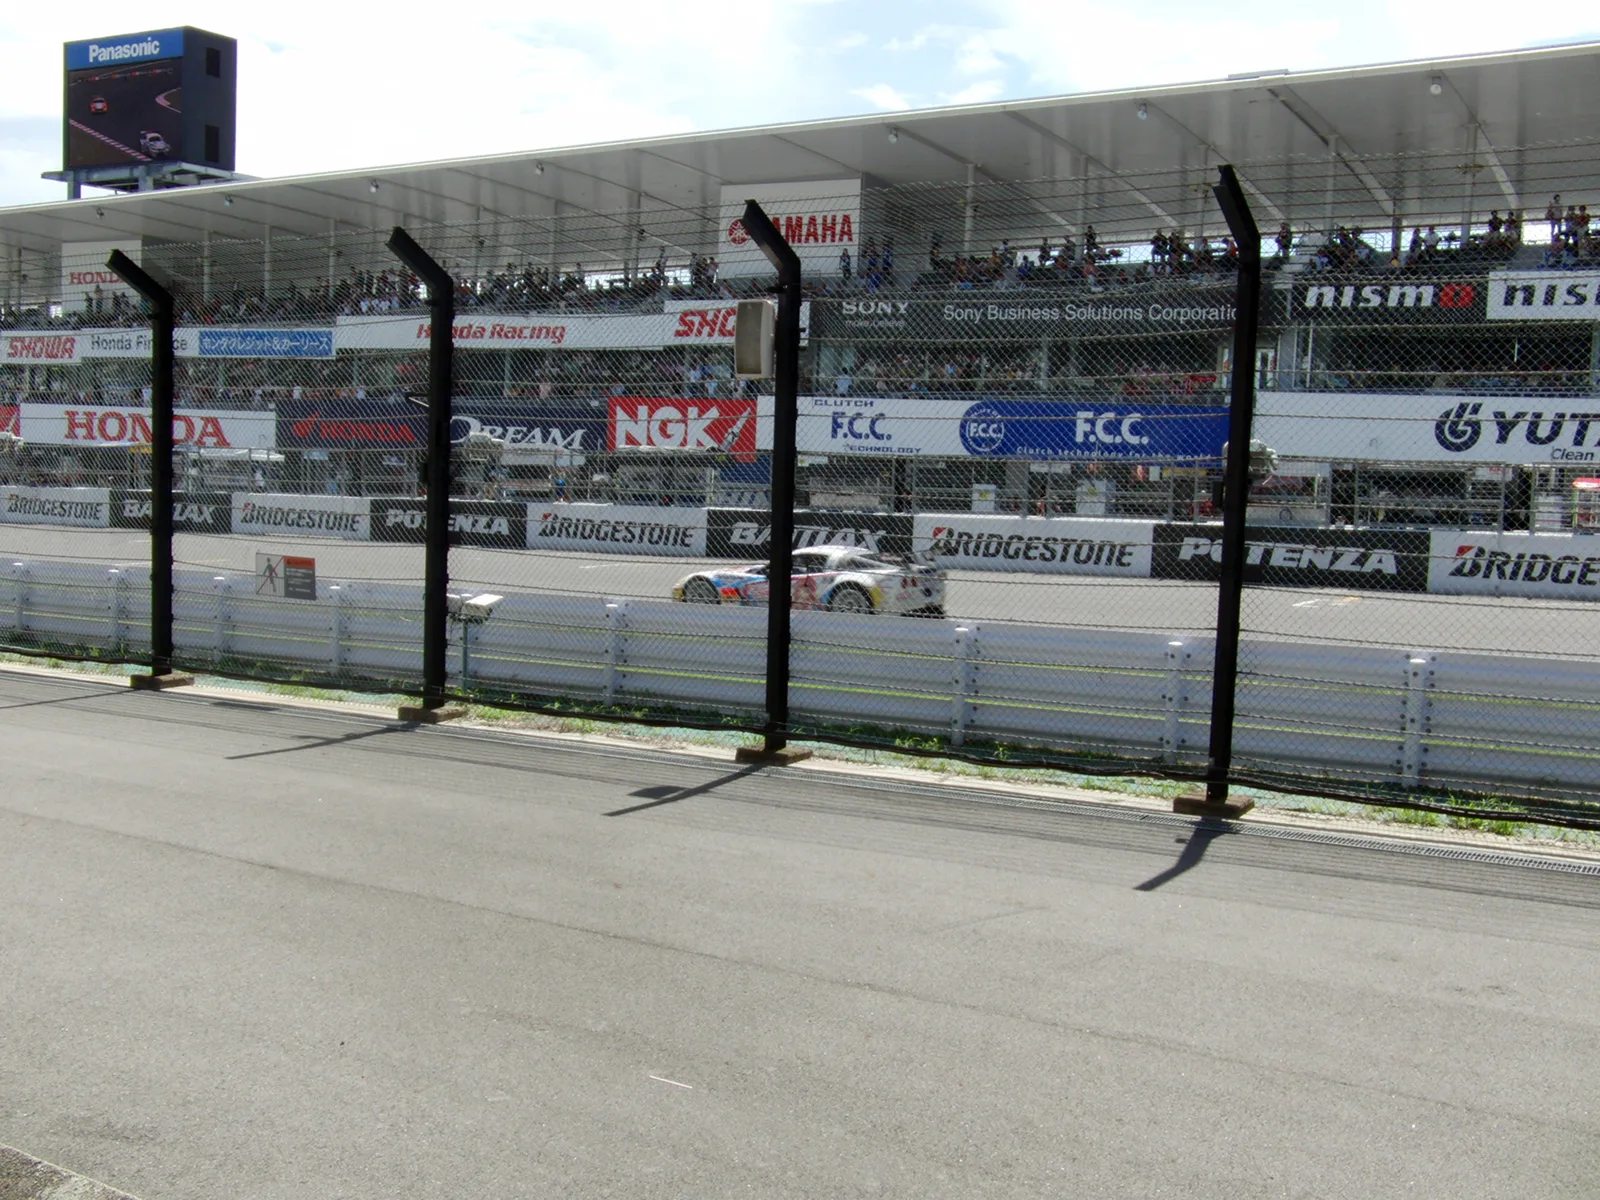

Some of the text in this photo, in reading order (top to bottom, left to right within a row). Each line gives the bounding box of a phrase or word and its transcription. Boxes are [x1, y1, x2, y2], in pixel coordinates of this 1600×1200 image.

[88, 37, 160, 63] Panasonic
[1503, 283, 1600, 307] nis
[842, 301, 909, 315] SONY
[943, 305, 982, 324] Sony
[986, 305, 1060, 321] Business
[1065, 304, 1143, 320] Solutions
[91, 334, 131, 349] Honda
[489, 324, 568, 344] Racing
[7, 336, 77, 359] SHOWA
[814, 399, 874, 408] CLUTCH
[65, 410, 231, 448] HONDA
[320, 420, 416, 443] HONDA
[616, 405, 720, 448] NGK
[831, 411, 893, 441] F.C.C.
[969, 422, 1001, 438] F.C.C.
[1075, 411, 1150, 445] F.C.C.
[1492, 411, 1600, 447] YUT
[1016, 445, 1053, 455] Clutch
[1551, 448, 1595, 461] Clean
[7, 494, 102, 521] BRIDGESTONE
[240, 502, 360, 533] BRIDGESTONE
[538, 512, 695, 548] BRIDGESTONE
[926, 527, 1134, 568] BRIDGESTONE
